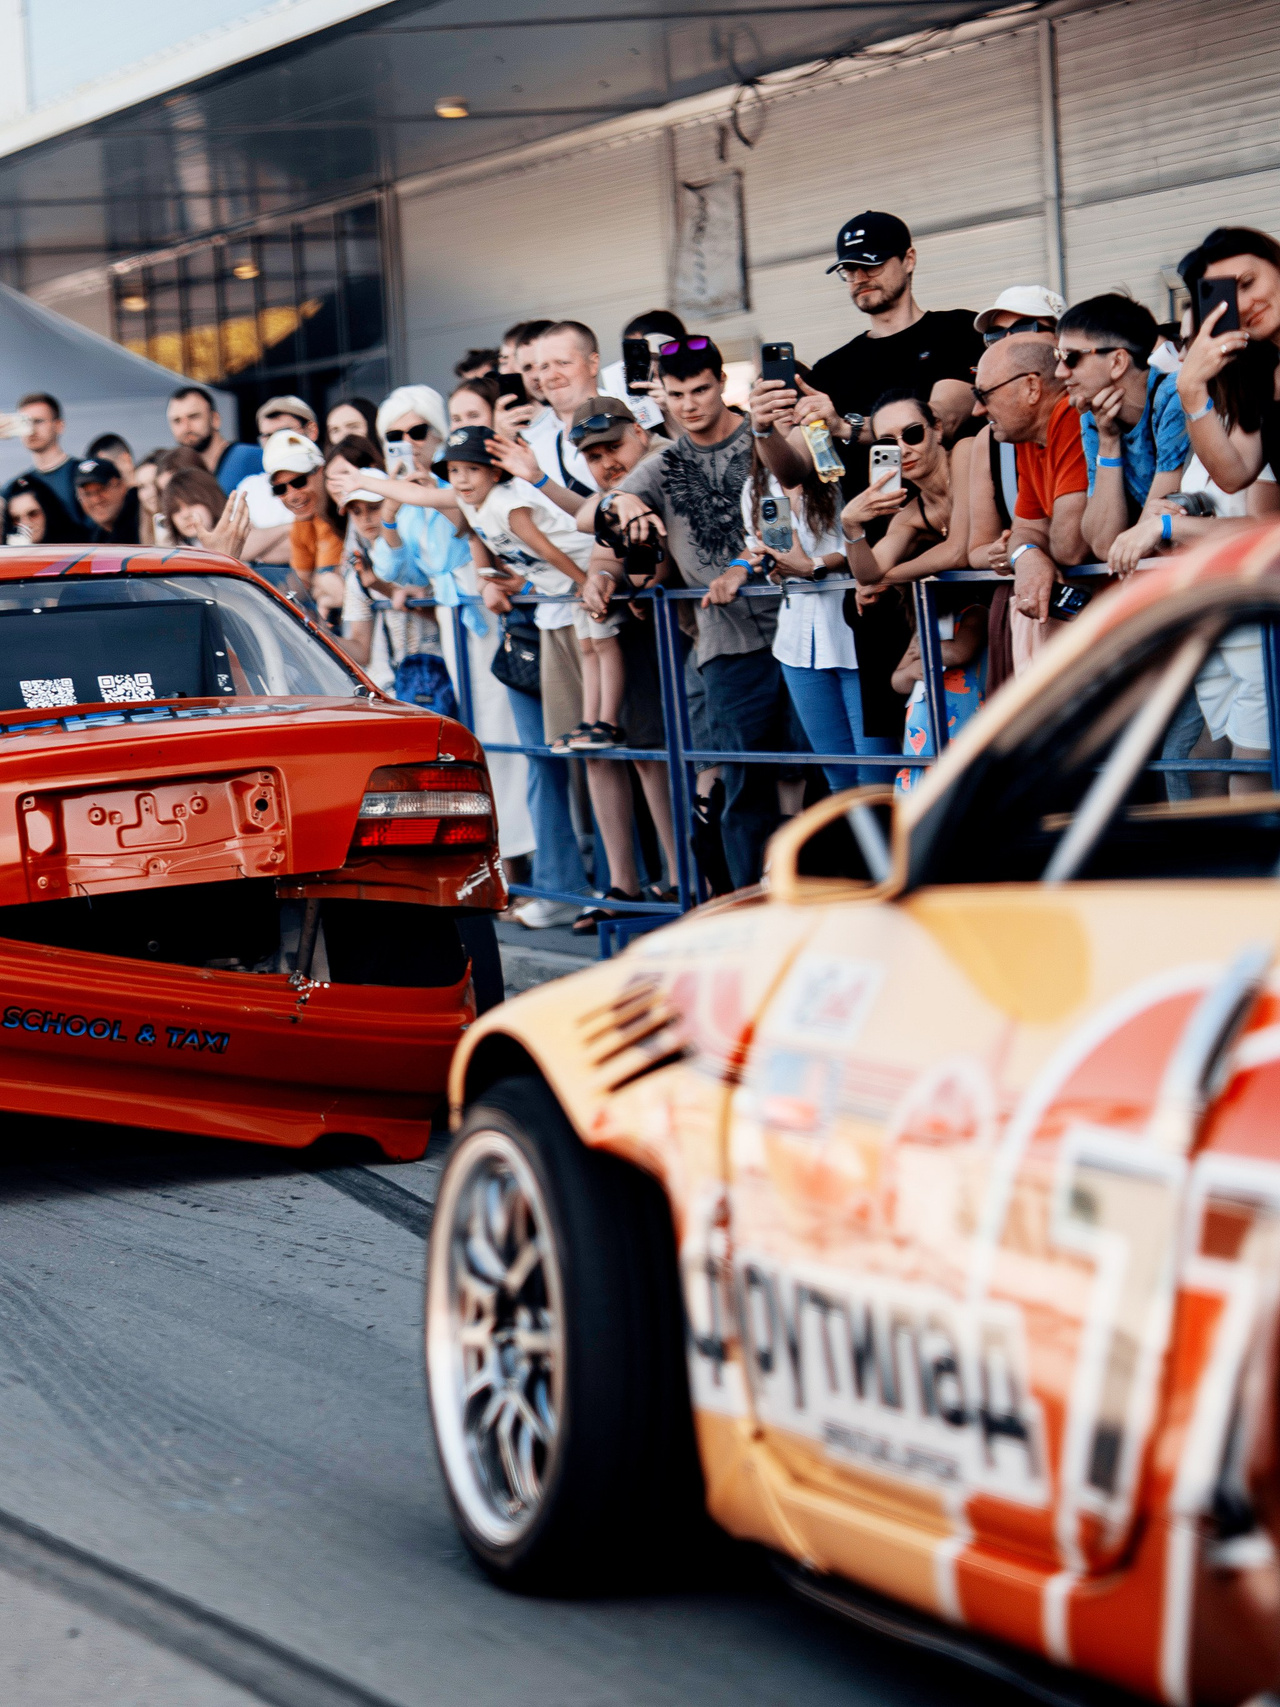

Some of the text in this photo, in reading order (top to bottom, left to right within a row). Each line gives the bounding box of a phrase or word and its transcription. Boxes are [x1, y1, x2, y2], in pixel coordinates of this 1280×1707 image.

[1, 1004, 231, 1055] SCHOOL & TAXI
